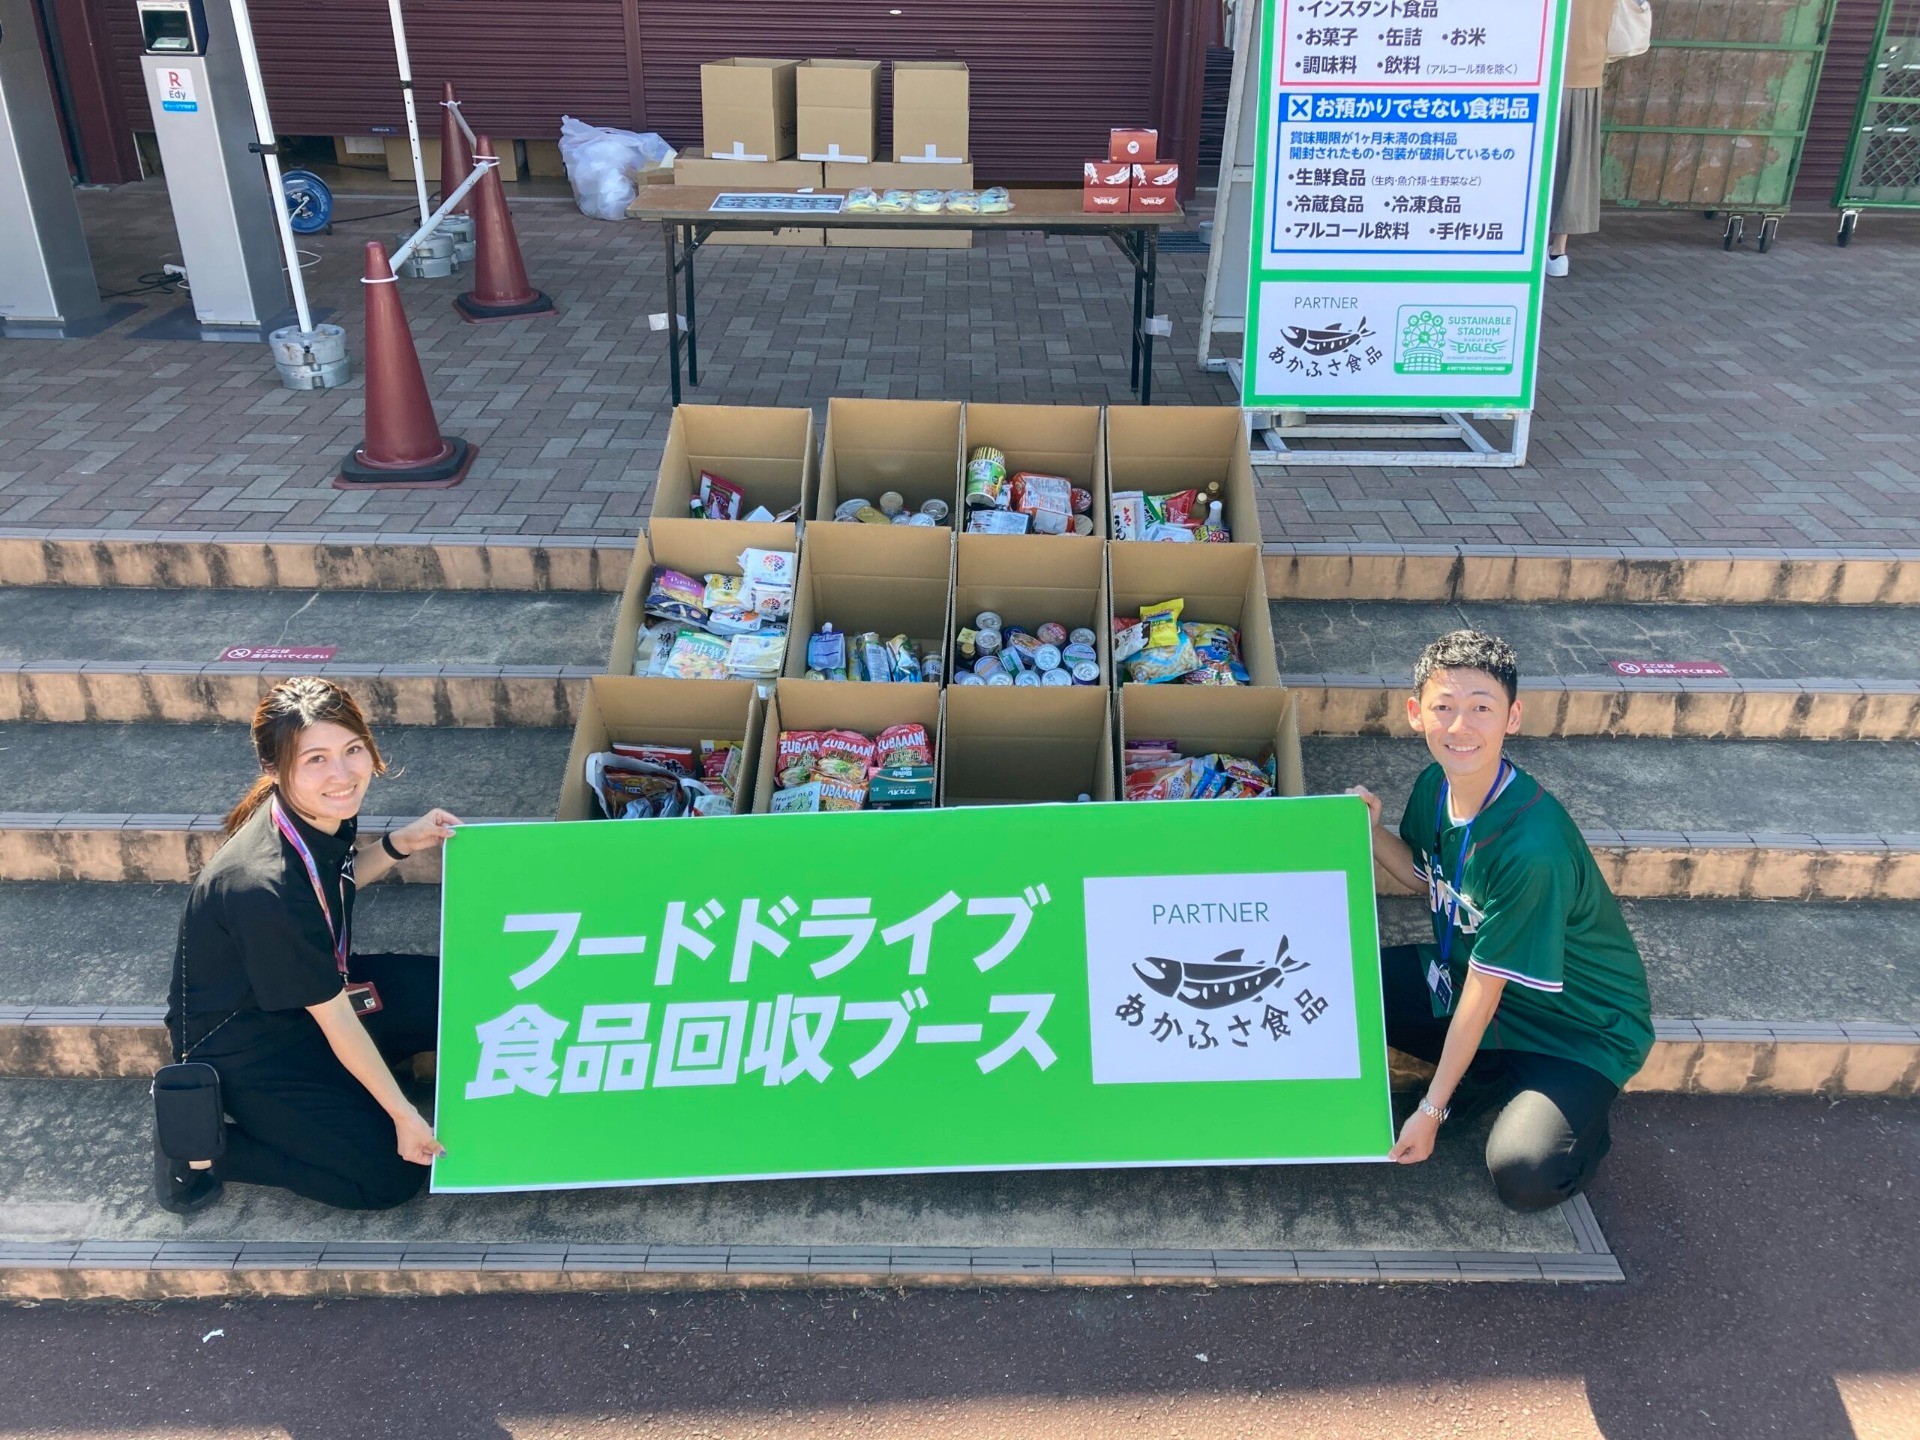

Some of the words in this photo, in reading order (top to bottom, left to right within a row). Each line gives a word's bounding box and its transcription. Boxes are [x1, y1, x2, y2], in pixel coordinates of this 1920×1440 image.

[1306, 0, 1438, 19] インスタント食品
[1305, 27, 1358, 47] お菓子
[1386, 27, 1422, 47] 缶詰
[1450, 27, 1486, 47] お米
[1303, 55, 1357, 74] 調味料
[1384, 55, 1421, 75] 飲料
[168, 71, 182, 87] R
[168, 90, 186, 100] Edy
[1315, 97, 1530, 120] お預かりできない食料品
[1290, 131, 1458, 146] 賞味期限が1ヶ月未満の食料品
[1289, 147, 1515, 161] 開封されたもの・包装が破損しているもの
[1295, 168, 1366, 187] 生鮮食品
[1293, 195, 1364, 214] 冷蔵食品
[1391, 195, 1462, 214] 冷凍食品
[1293, 221, 1410, 241] アルコール飲料
[1436, 222, 1503, 241] 手作り品
[1294, 296, 1358, 309] PARTNER
[1447, 316, 1512, 325] SUSTAINABLE
[1457, 327, 1500, 336] STADIUM
[1457, 342, 1498, 354] EAGLES
[1268, 345, 1383, 377] あかふさ食品
[1152, 901, 1270, 925] PARTNER
[503, 882, 1051, 991] フードドライブ
[1114, 988, 1329, 1050] あかふさ食品
[464, 986, 1058, 1101] 食品回収ブース
